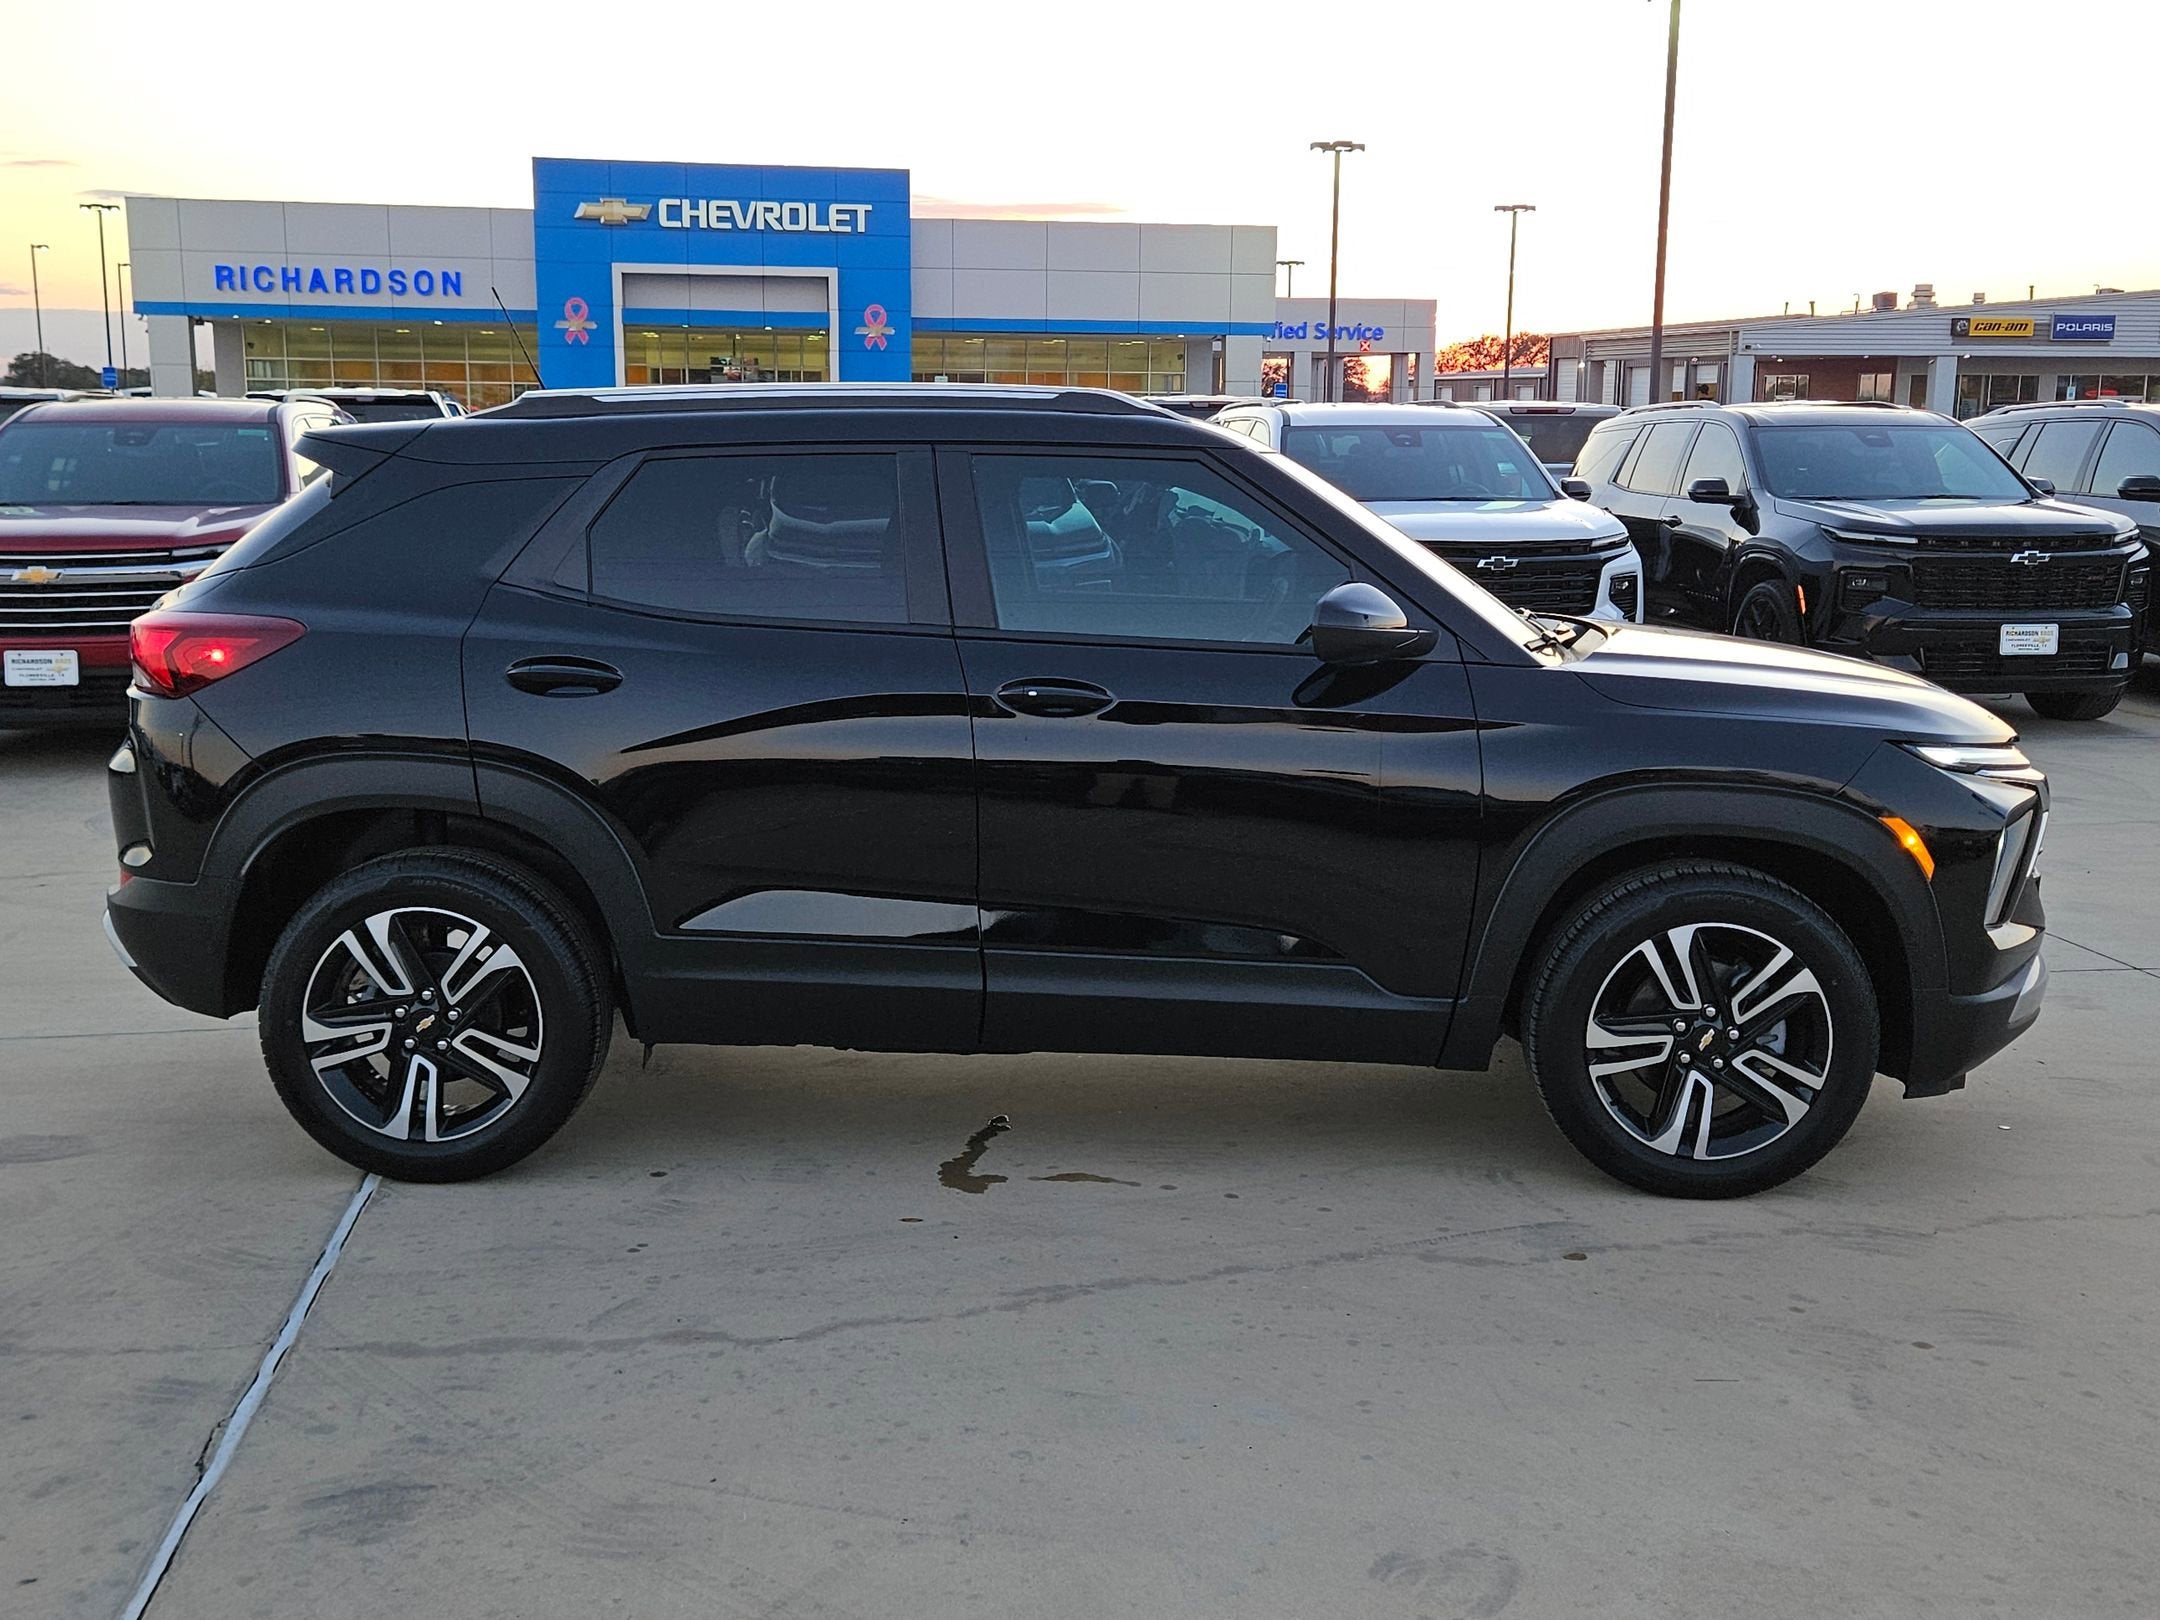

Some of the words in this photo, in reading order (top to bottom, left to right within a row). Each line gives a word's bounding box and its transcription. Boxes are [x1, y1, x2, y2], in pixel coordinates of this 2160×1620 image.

[658, 198, 873, 233] CHEVROLET
[214, 264, 463, 297] RICHARDSON
[1974, 321, 2029, 332] can-am
[2056, 323, 2114, 332] POLARIS
